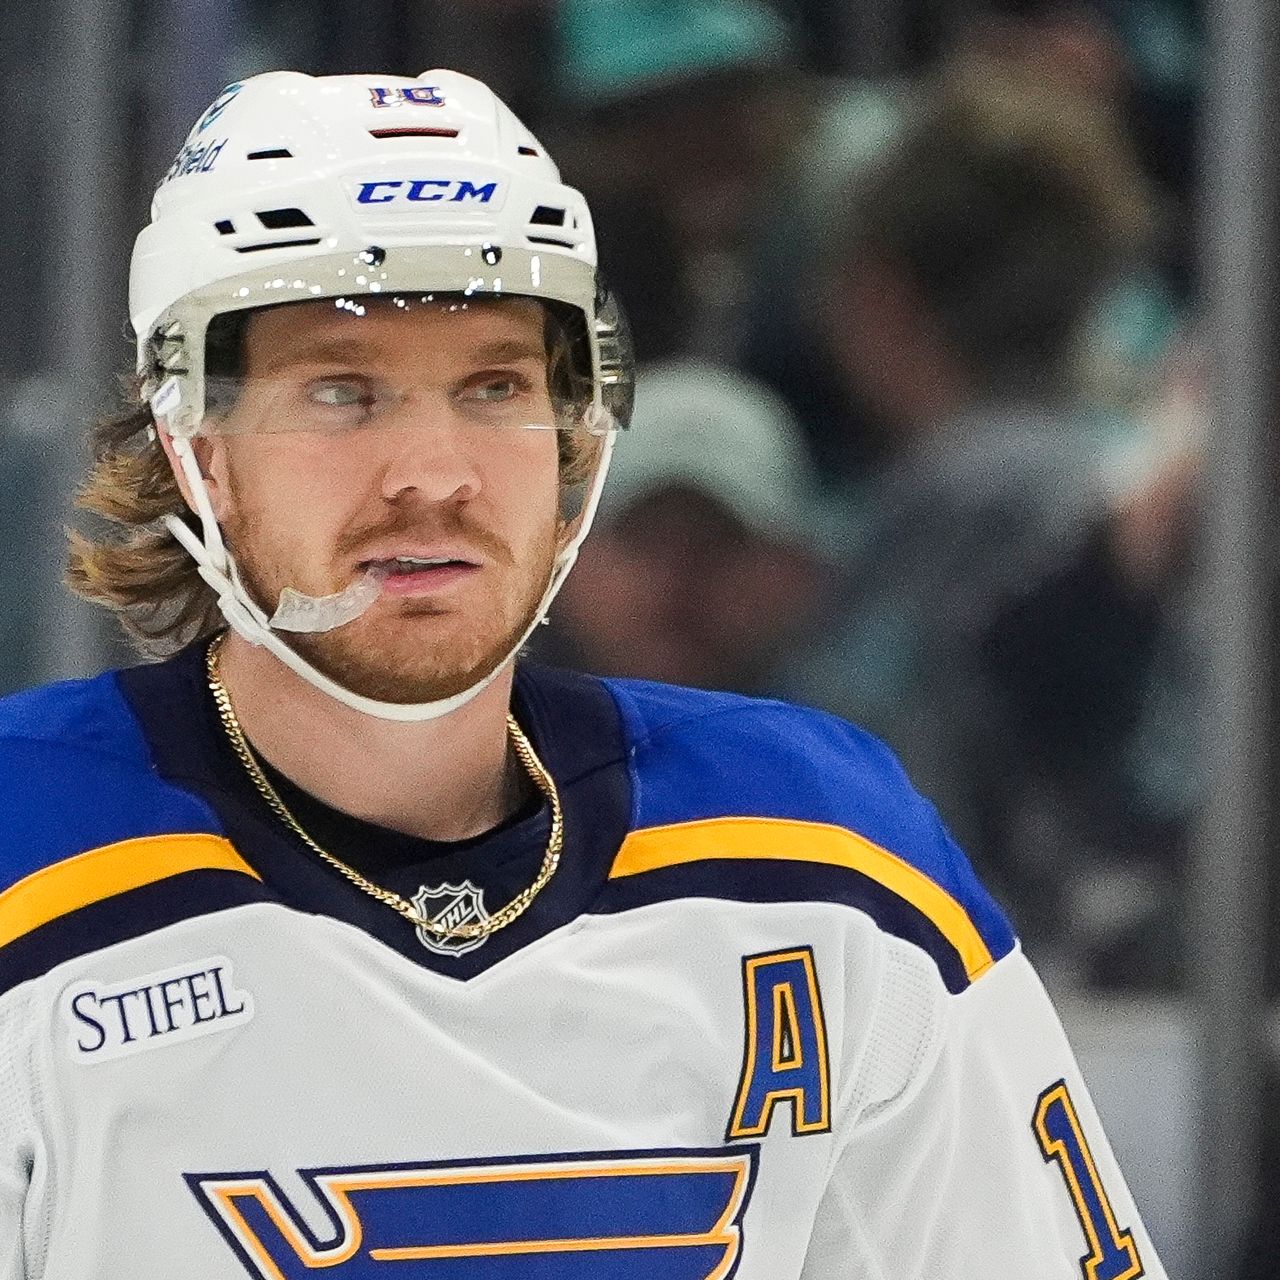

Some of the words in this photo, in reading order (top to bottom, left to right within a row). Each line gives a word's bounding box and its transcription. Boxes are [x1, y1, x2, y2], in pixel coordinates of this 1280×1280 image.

[357, 180, 498, 204] CCM
[71, 966, 245, 1053] STIFEL
[725, 945, 832, 1142] A
